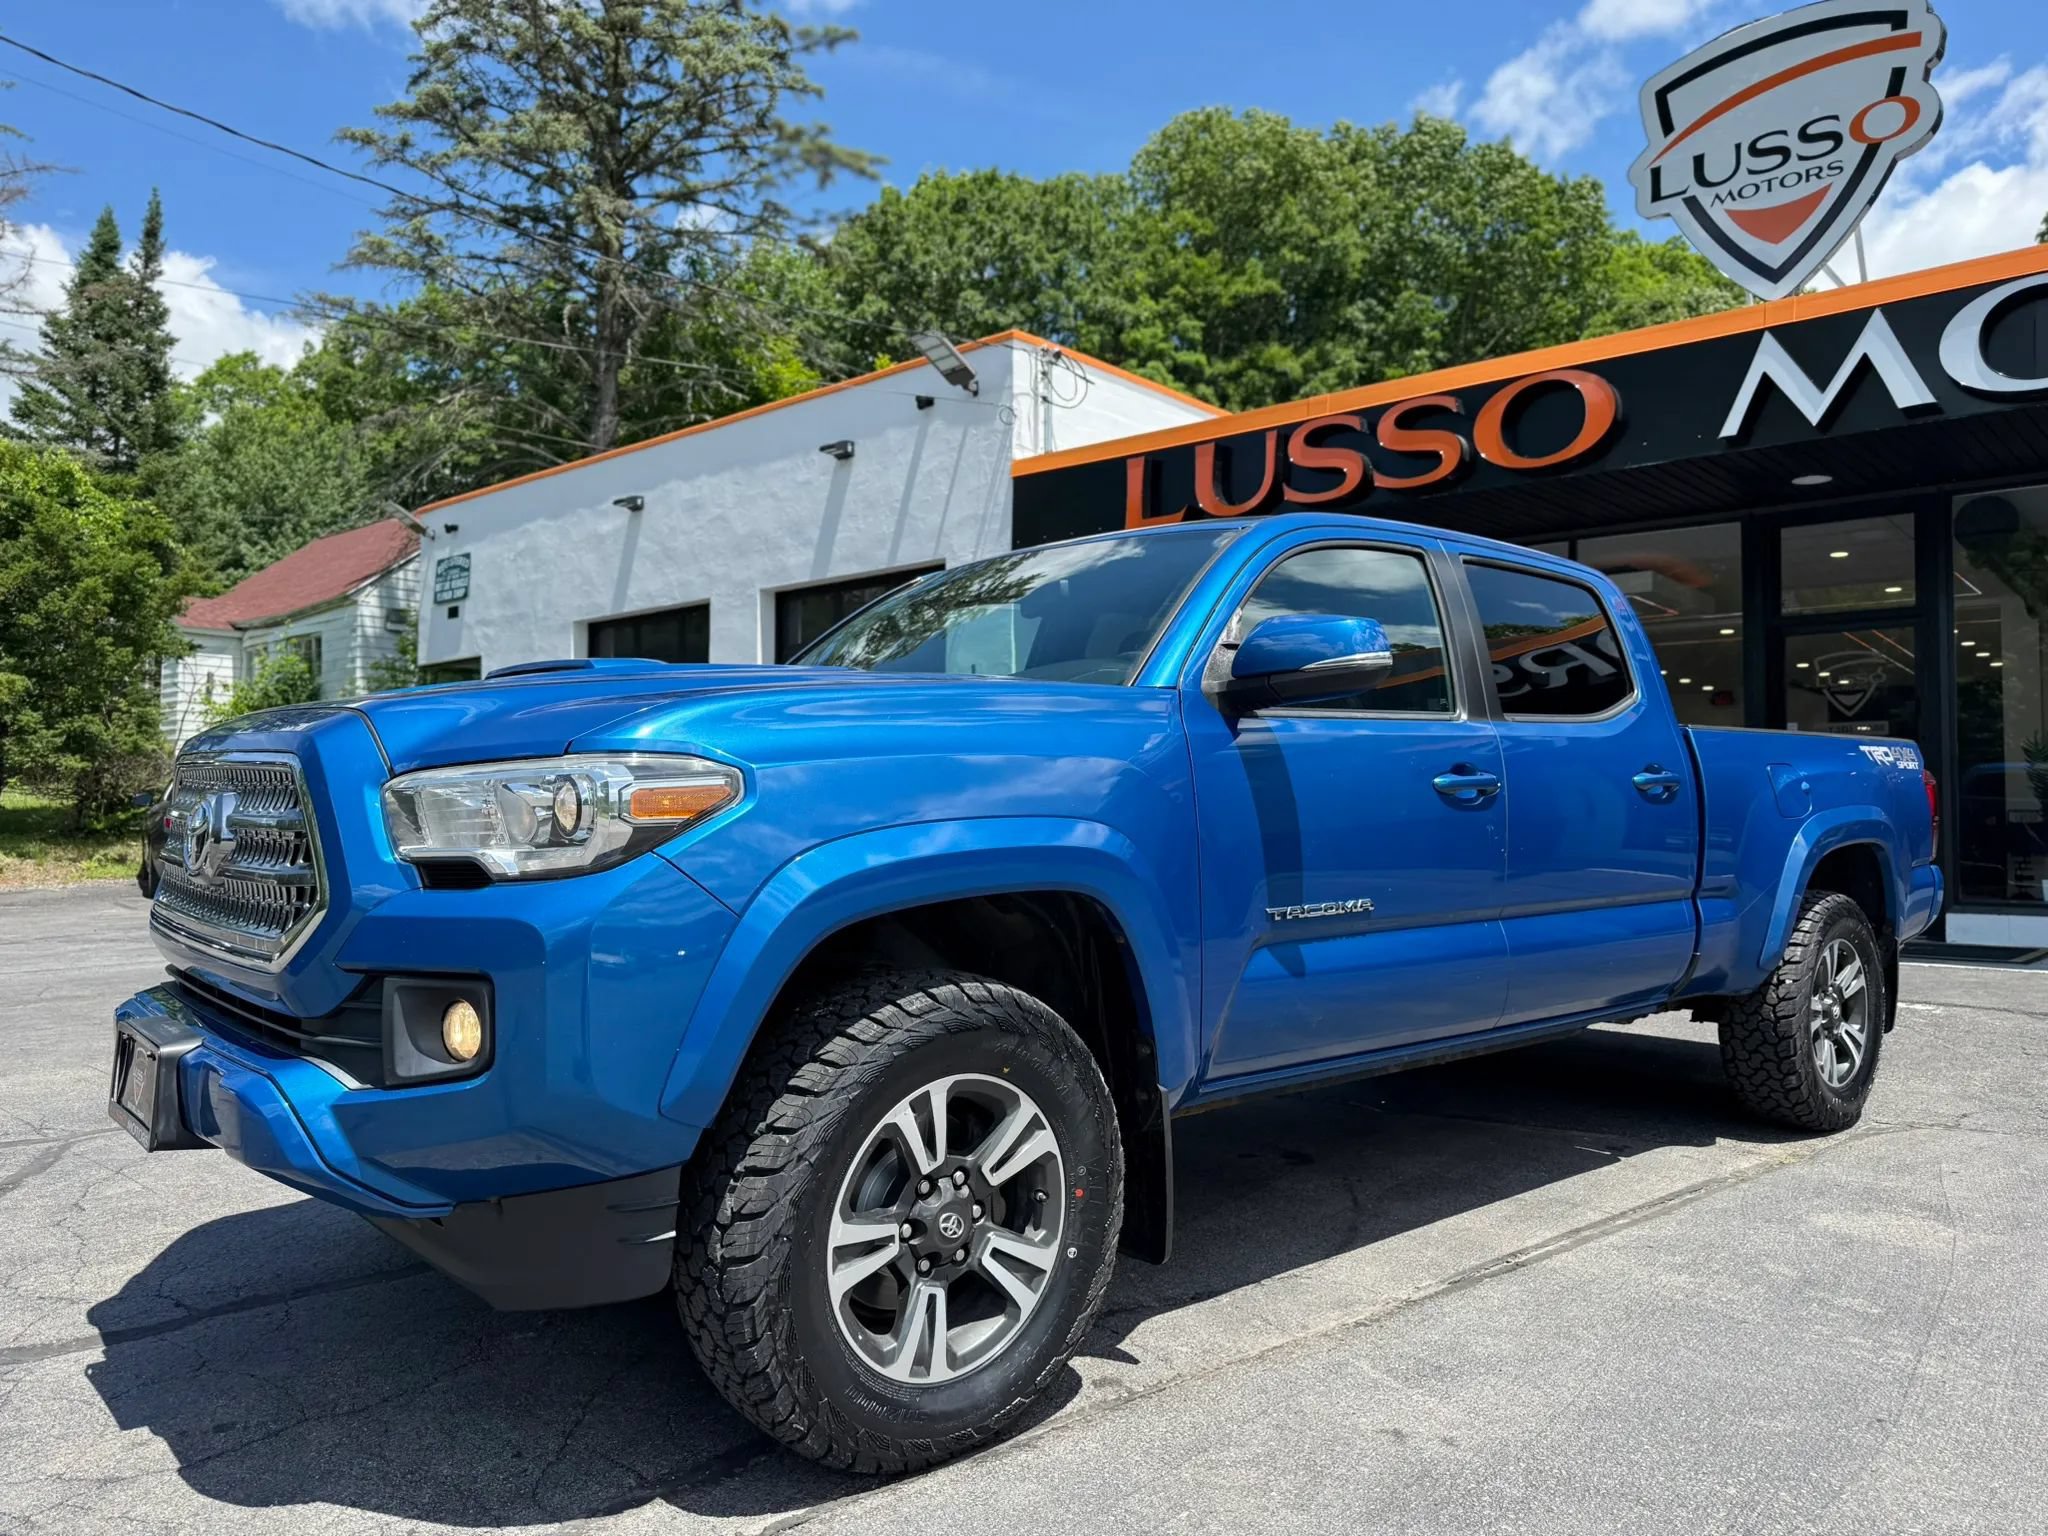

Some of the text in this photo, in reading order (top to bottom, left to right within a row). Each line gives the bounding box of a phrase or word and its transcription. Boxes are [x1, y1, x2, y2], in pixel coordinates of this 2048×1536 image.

[1650, 95, 1921, 204] LUSSO
[1710, 160, 1845, 208] MOTORS
[1125, 368, 1620, 530] LUSSO
[1858, 745, 1895, 766] TRD
[1896, 760, 1919, 770] SPORT
[1265, 898, 1375, 921] TACOMA
